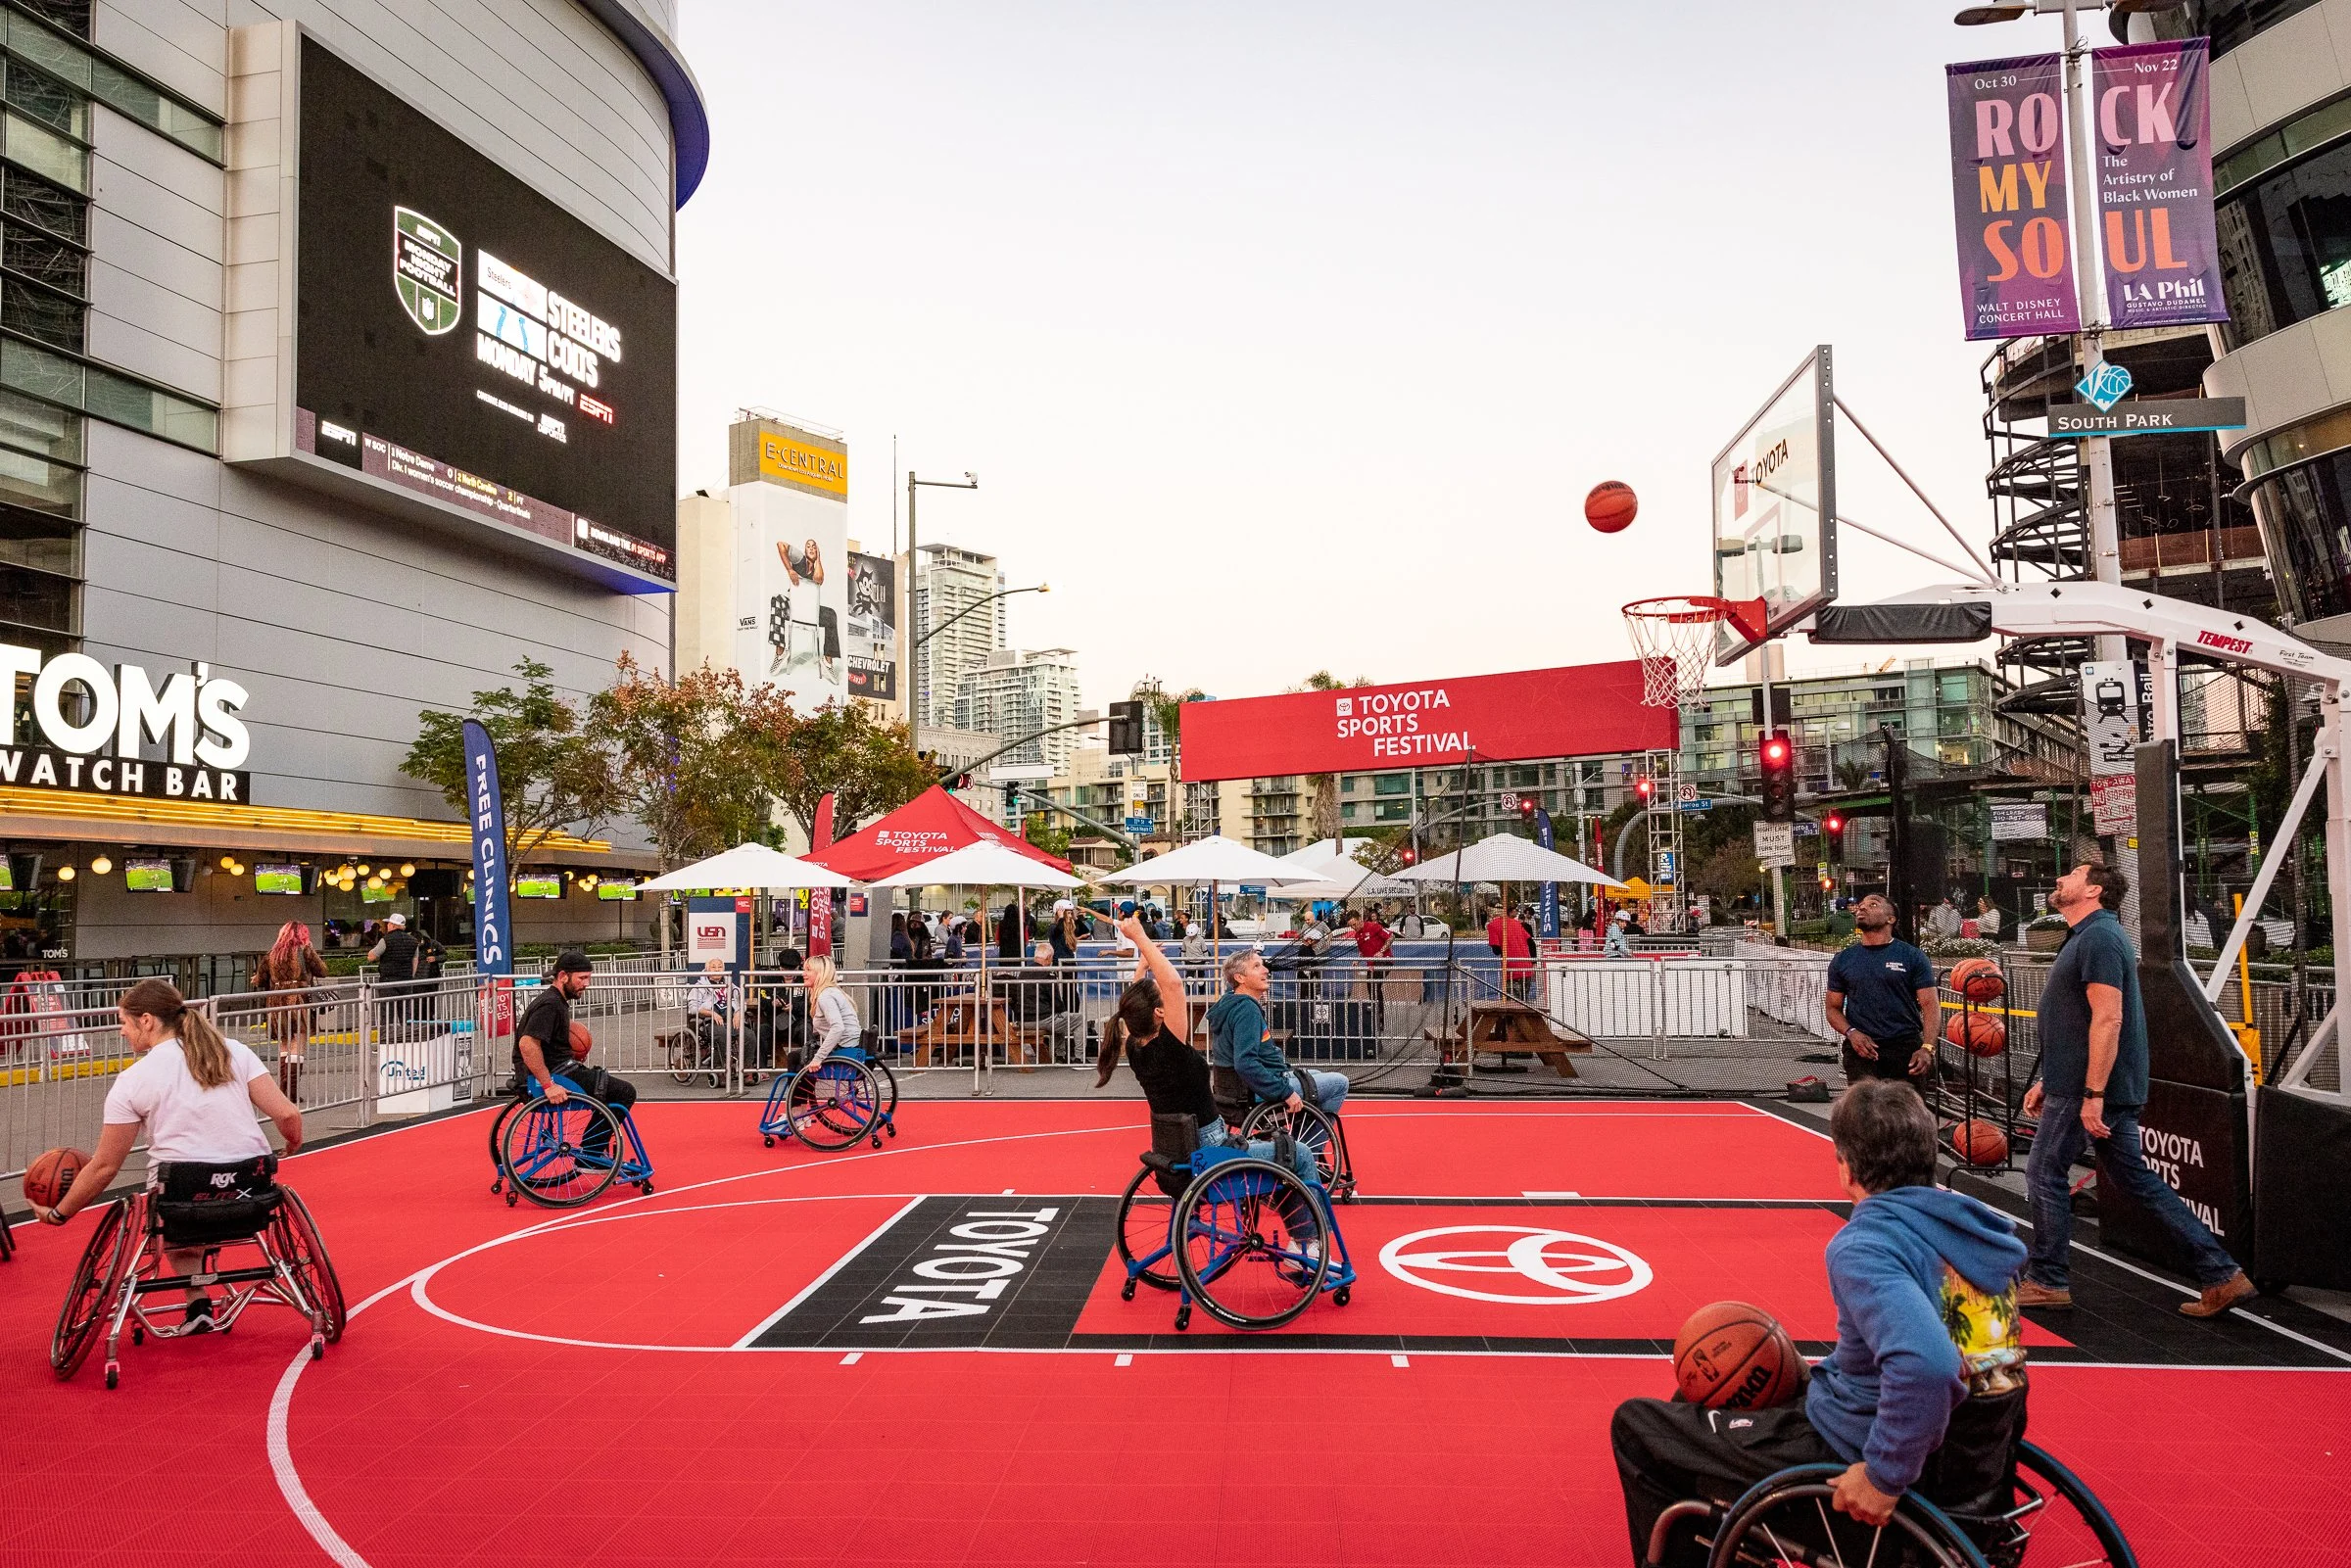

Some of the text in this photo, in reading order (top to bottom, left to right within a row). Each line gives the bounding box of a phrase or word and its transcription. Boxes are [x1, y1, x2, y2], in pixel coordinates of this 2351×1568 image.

[2135, 59, 2179, 73] Nov 22
[1975, 75, 2017, 90] Oct 30
[1976, 92, 2058, 159] RO
[2099, 81, 2178, 146] CK
[2102, 155, 2128, 167] The
[1979, 160, 2051, 214] MY
[2103, 167, 2176, 185] Artistry of
[2103, 187, 2198, 204] Black Women
[1984, 216, 2064, 282] SO
[2105, 207, 2188, 273] UL
[404, 239, 452, 273] MONDAY
[410, 254, 447, 280] NIGHT
[399, 258, 456, 298] FOOTBALL
[487, 266, 512, 290] Steelers
[2123, 278, 2205, 302] LA Phil
[1977, 298, 2061, 312] WALT DISNEY
[2166, 298, 2206, 307] DUDAMEL
[548, 290, 621, 363] STEELERS
[1979, 309, 2065, 324] CONCERT HALL
[477, 331, 537, 386] MONDAY
[548, 330, 600, 389] COLTS
[580, 393, 614, 425] ESPN
[321, 419, 357, 447] ESPN
[364, 438, 387, 453] W SOC
[396, 449, 415, 464] Notre
[415, 454, 435, 472] Dame
[447, 467, 454, 479] 0
[408, 468, 435, 484] women's
[435, 477, 455, 492] soccer
[455, 484, 494, 507] championship
[461, 472, 478, 490] North
[478, 480, 498, 496] Carolina
[507, 491, 513, 501] 2
[590, 526, 621, 547] DOWNLOAD
[620, 539, 632, 551] THE
[637, 544, 656, 560] SPORTS
[656, 551, 666, 563] APP
[739, 616, 756, 627] VANS
[2196, 630, 2253, 654] TEMPEST
[2279, 648, 2316, 661] First Team
[847, 655, 890, 674] CHEVROLET
[0, 641, 251, 770] TOM'S
[1359, 689, 1451, 715] TOYOTA
[1337, 713, 1418, 738] SPORTS
[1373, 731, 1477, 757] FESTIVAL
[166, 766, 238, 801] BAR
[2091, 788, 2135, 806] NO STOPPIN
[2098, 806, 2113, 817] ANY
[875, 837, 927, 847] SPORTS
[892, 831, 948, 840] TOYOTA
[476, 753, 503, 966] FREE CLINICS
[895, 845, 957, 855] FESTIVAL
[41, 946, 69, 959] TOM'S
[388, 1066, 426, 1077] Unted
[2136, 1125, 2204, 1168] TOYOTA
[858, 1207, 1060, 1324] TOYOTA
